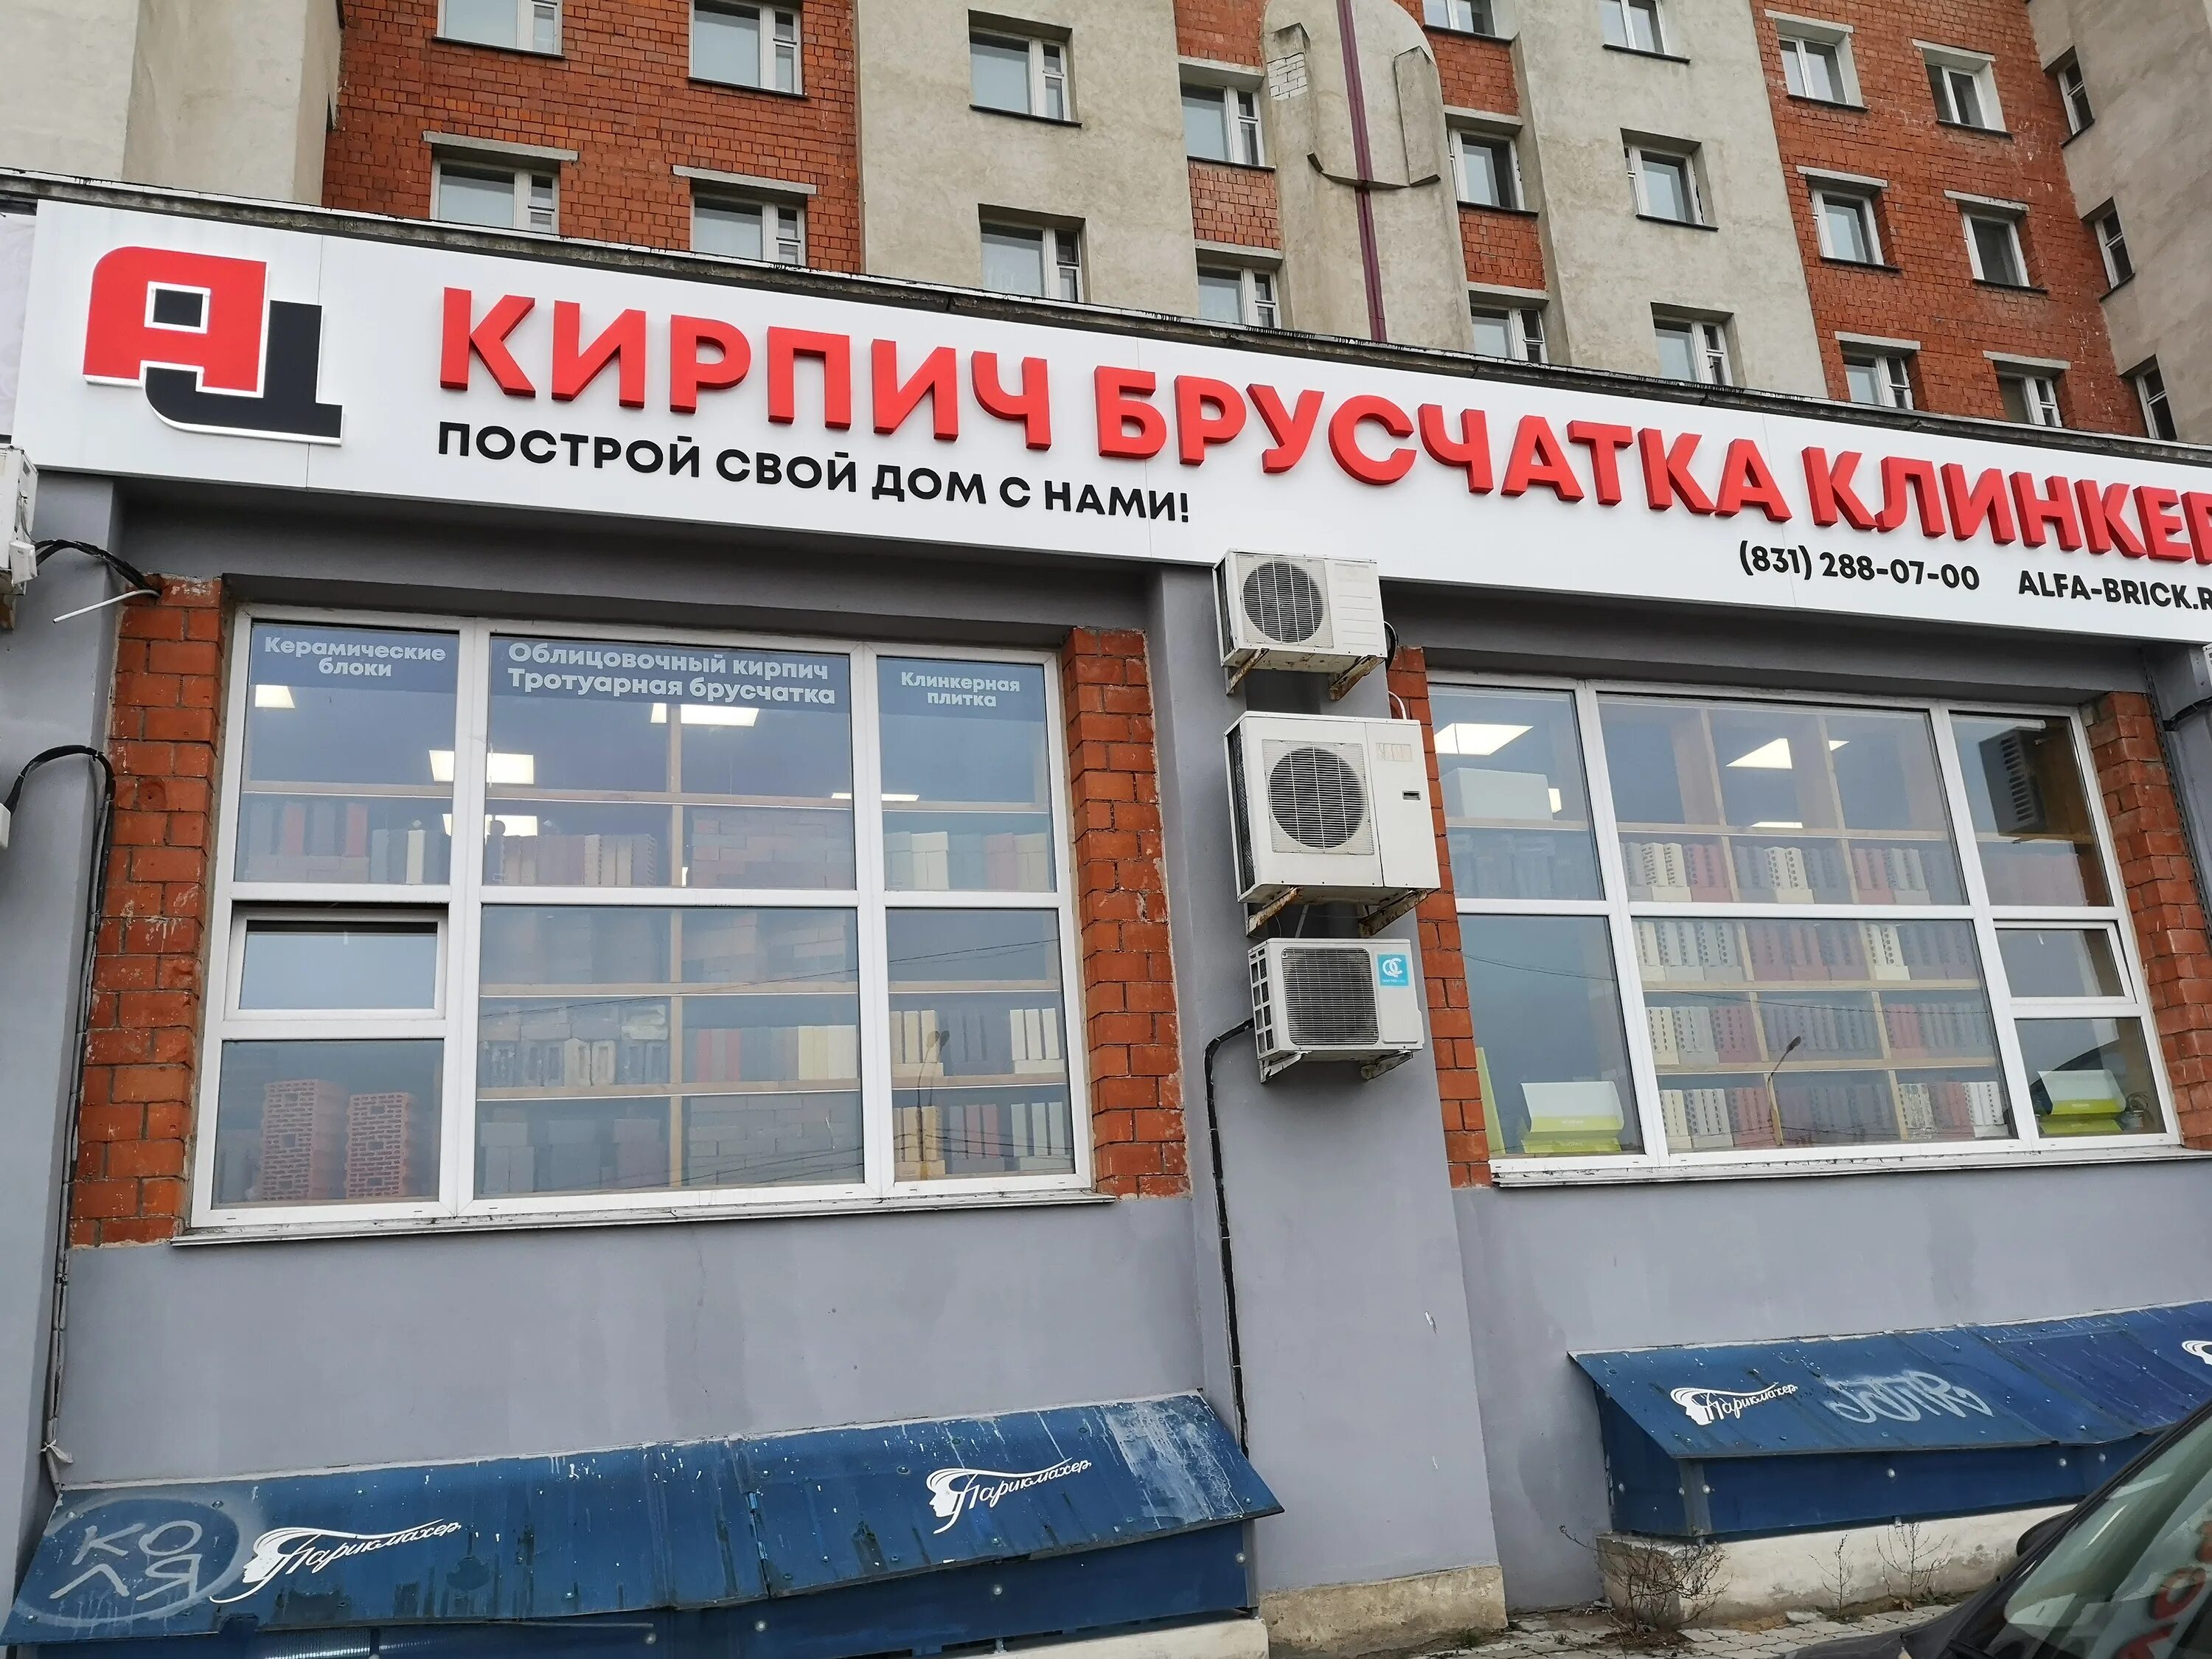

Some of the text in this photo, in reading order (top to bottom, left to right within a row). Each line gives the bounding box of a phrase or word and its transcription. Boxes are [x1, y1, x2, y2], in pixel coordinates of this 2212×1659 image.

[440, 287, 1052, 451] КИРПИЧ
[1094, 366, 1792, 523] БРУСЧАТКА
[439, 421, 1189, 522] ПОСТРОЙ СВОЙ ДОМ С НАМИ!
[1739, 540, 1980, 591] (831) 288-07-00
[265, 636, 446, 661] Керамические
[319, 657, 392, 677] блоки
[508, 642, 828, 681] Облицовочный кирпич
[507, 667, 835, 704] Тротуарная брусчатка
[901, 672, 1020, 693] Клинкерная
[927, 692, 997, 707] плитка
[947, 1460, 1092, 1519] Парикмахер
[262, 1519, 462, 1582] Парикмахер
